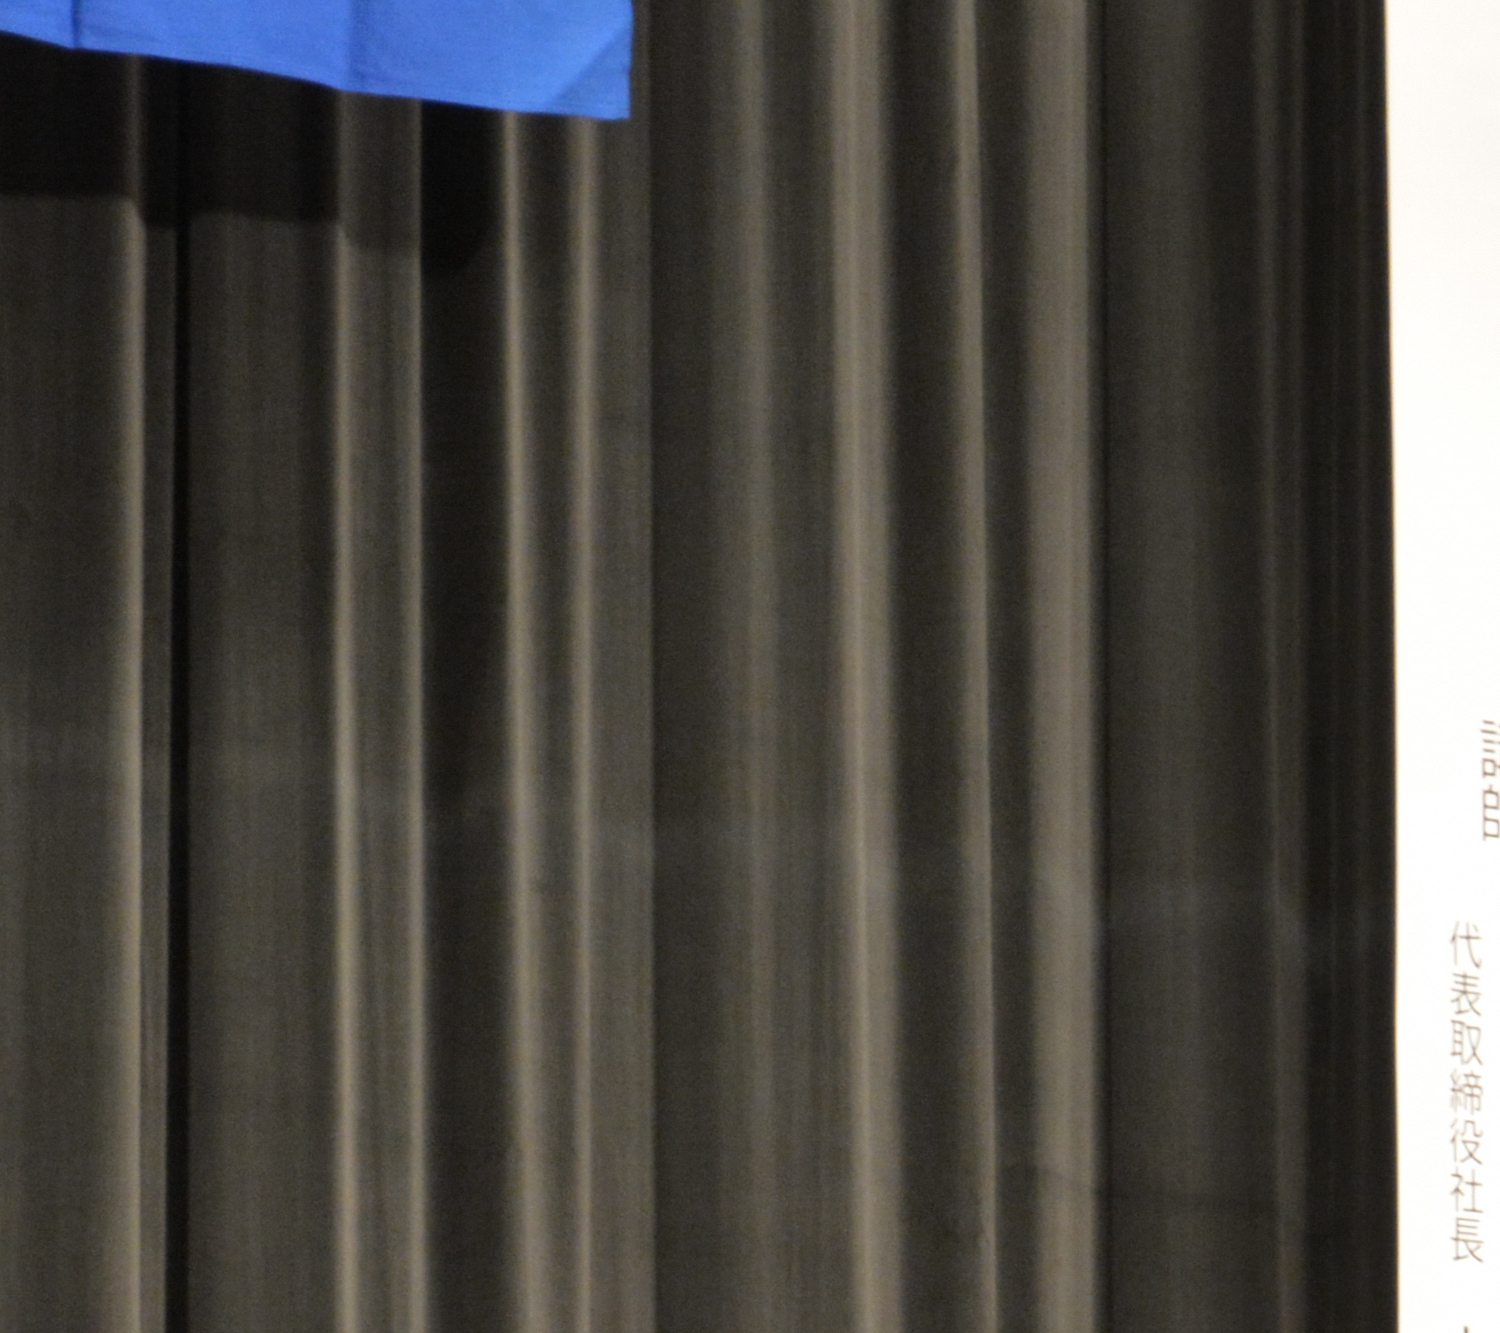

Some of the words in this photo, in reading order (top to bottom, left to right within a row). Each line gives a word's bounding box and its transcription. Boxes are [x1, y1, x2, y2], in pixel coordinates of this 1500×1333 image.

[1449, 918, 1485, 1264] 代表取締役社長
